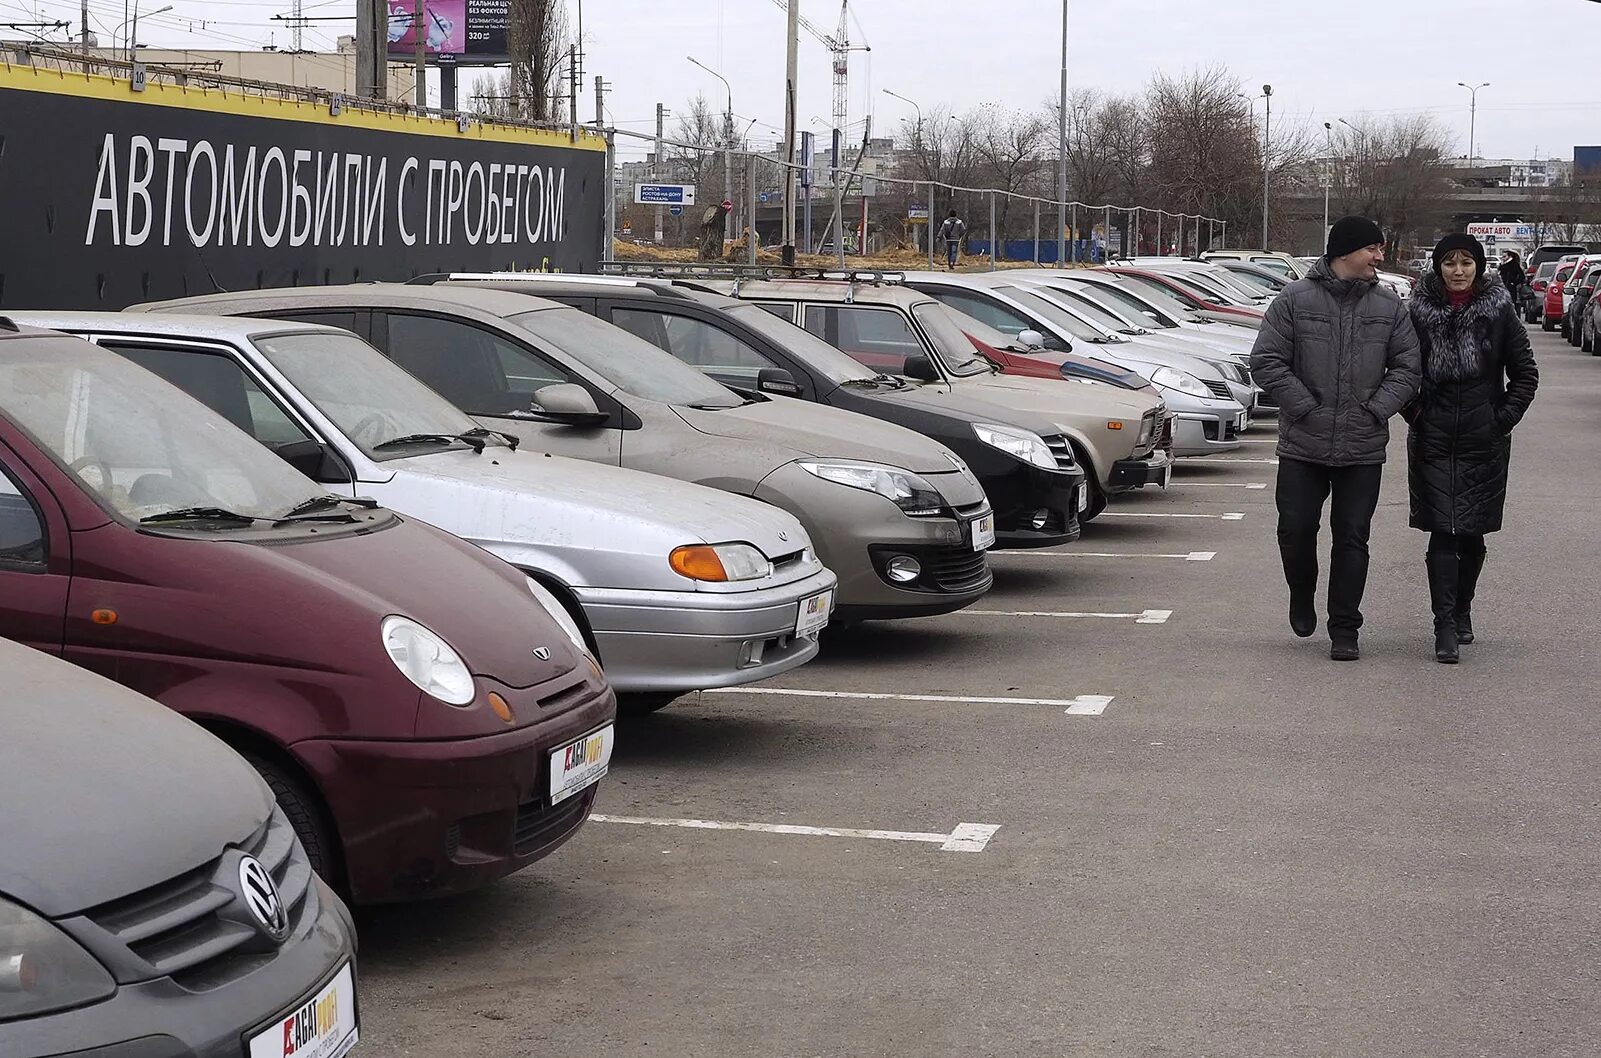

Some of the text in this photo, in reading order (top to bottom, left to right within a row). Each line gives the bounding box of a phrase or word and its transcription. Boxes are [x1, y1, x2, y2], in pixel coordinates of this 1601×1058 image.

[468, 32, 482, 40] 320
[136, 71, 144, 84] 10
[85, 133, 565, 248] АВТОМОБИЛИ С ПРОБЕГОМ
[1469, 227, 1511, 235] ПРОКАТ АВТО
